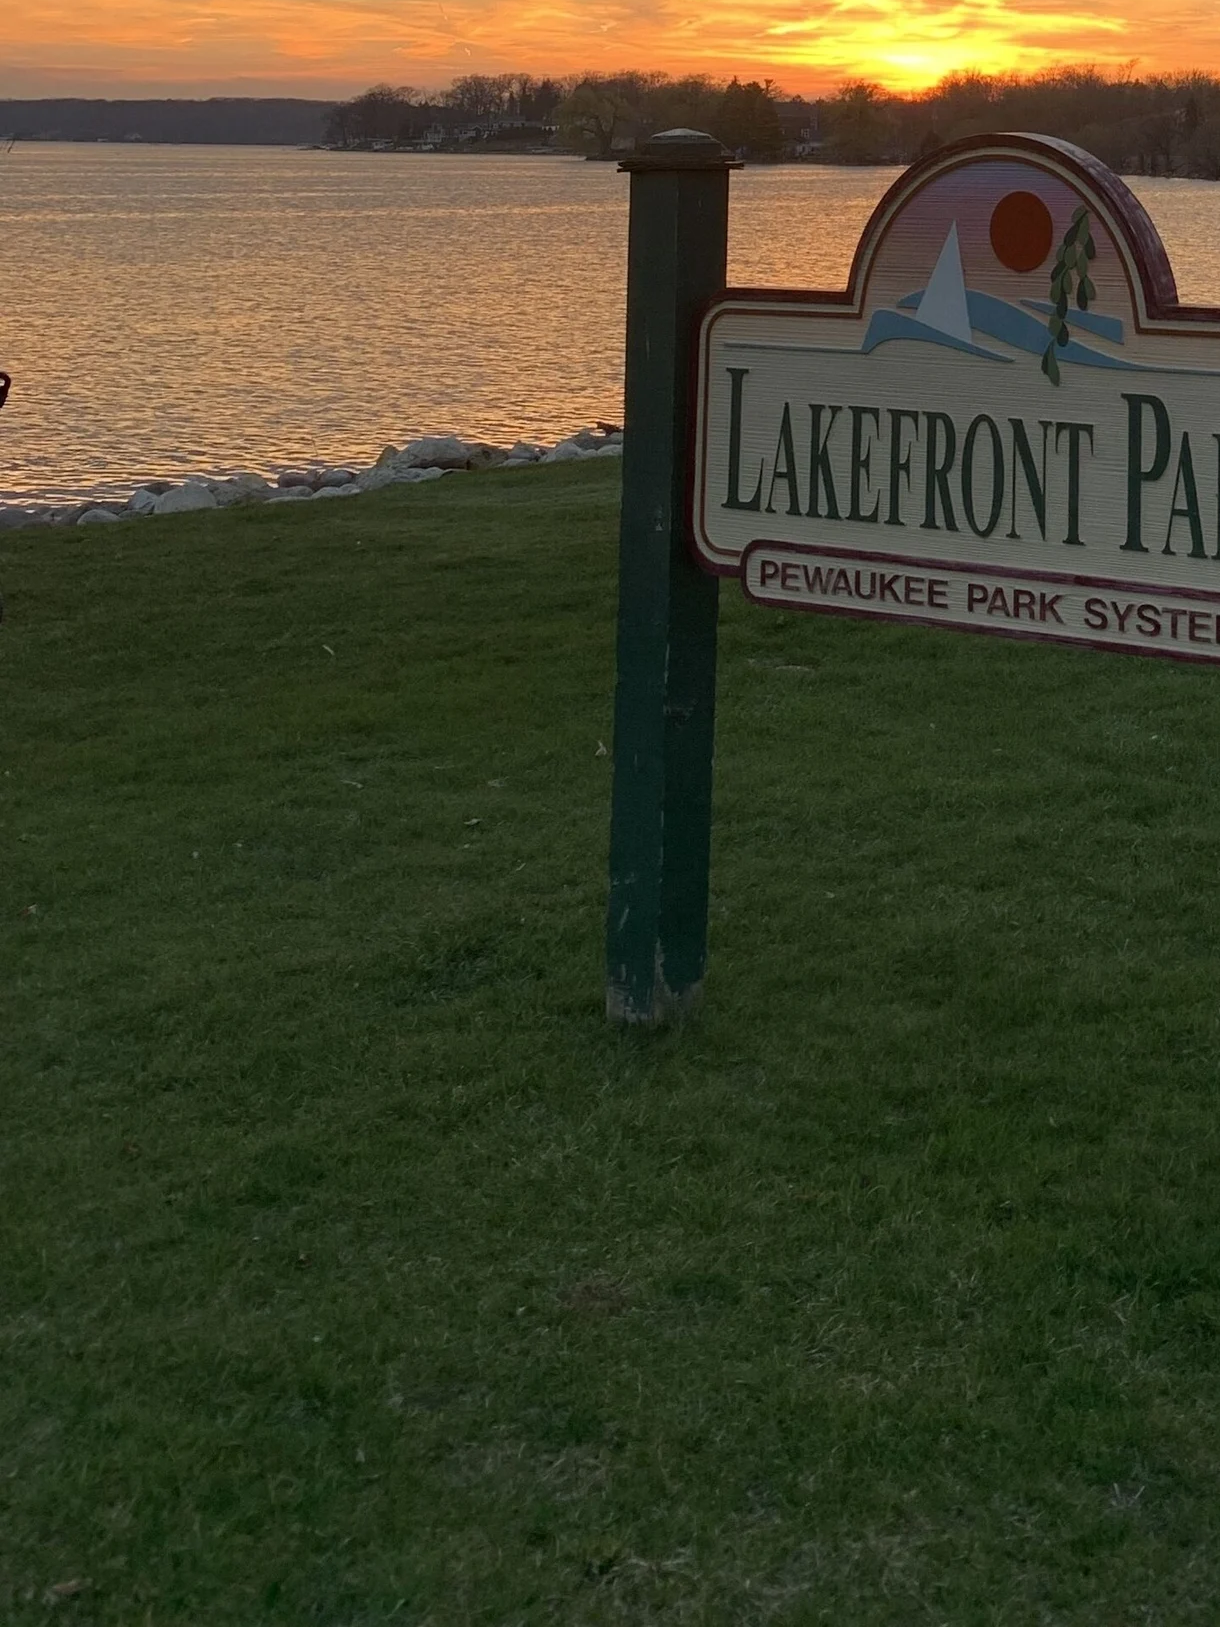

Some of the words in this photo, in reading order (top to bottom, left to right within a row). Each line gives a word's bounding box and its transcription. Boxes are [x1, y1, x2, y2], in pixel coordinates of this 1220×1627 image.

[721, 367, 1094, 546] LAKEFRONT
[759, 559, 949, 610] PEWAUKEE
[967, 582, 1064, 624] PARK
